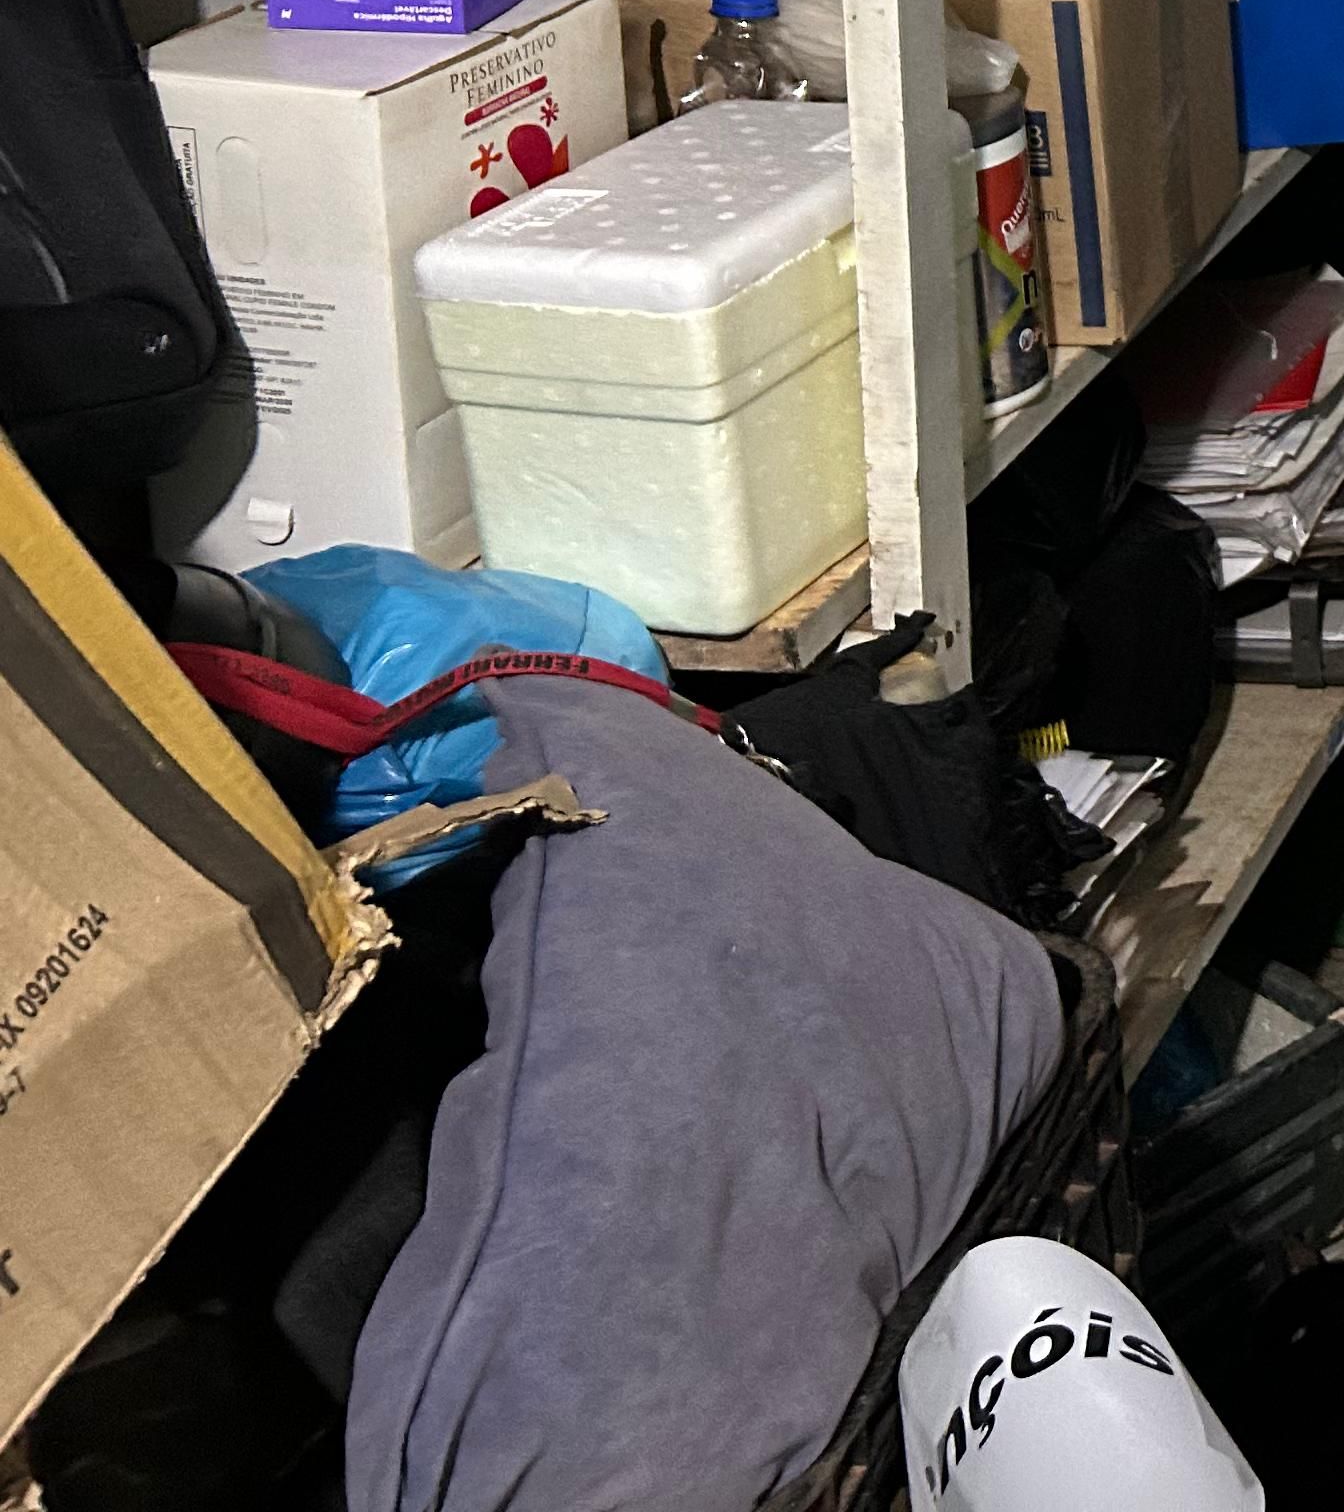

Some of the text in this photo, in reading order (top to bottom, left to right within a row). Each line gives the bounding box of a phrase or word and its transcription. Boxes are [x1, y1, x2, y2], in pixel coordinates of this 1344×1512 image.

[449, 31, 557, 94] PRESERVATIVO
[466, 58, 545, 108] FEMININO
[15, 904, 111, 1022] 09201624
